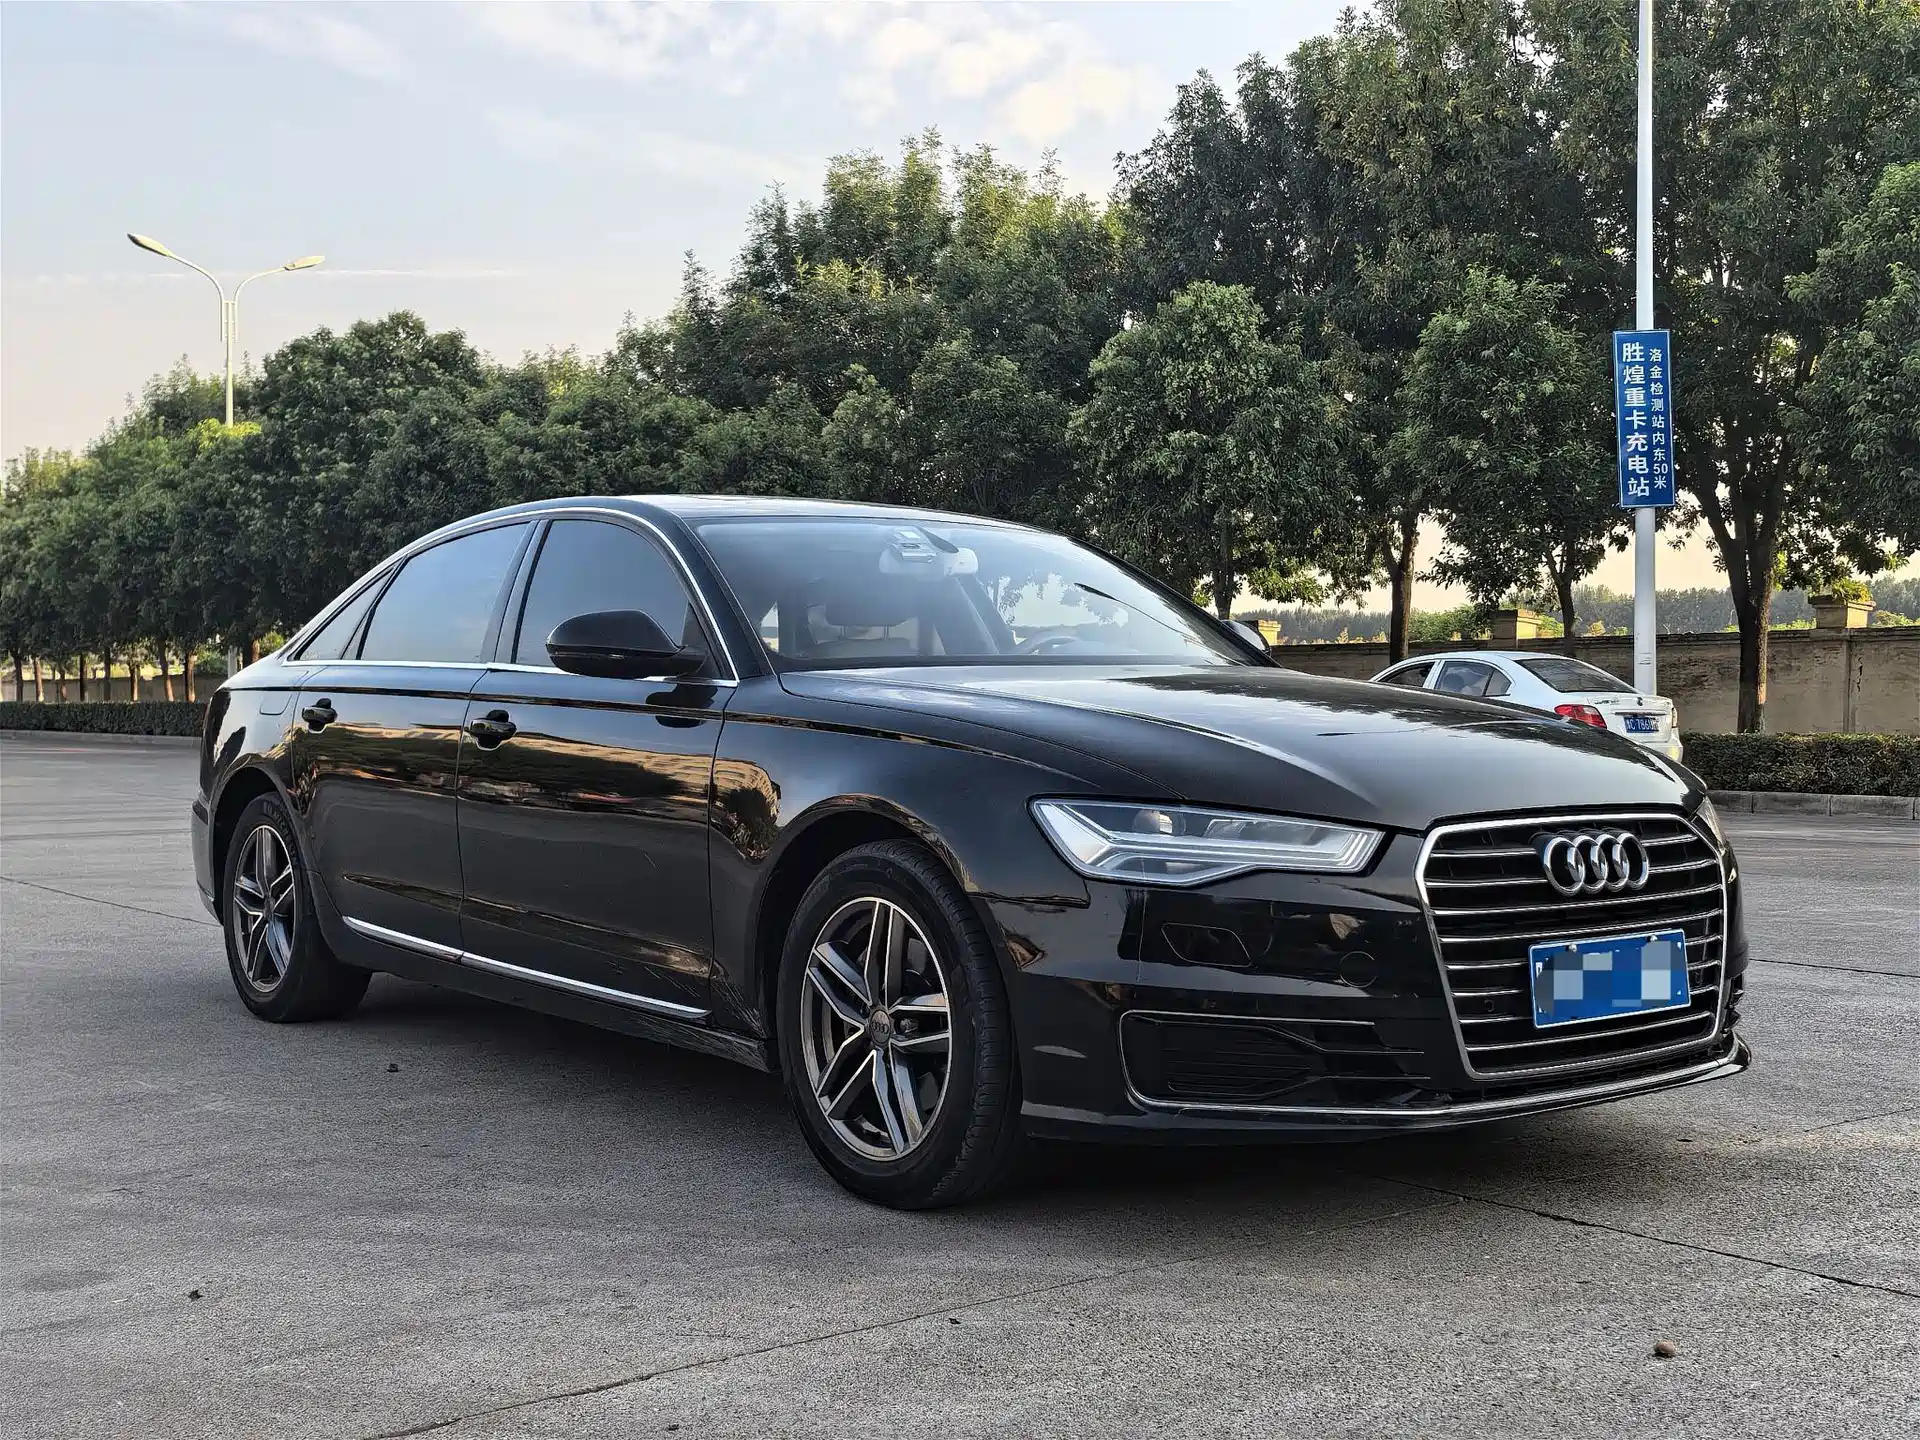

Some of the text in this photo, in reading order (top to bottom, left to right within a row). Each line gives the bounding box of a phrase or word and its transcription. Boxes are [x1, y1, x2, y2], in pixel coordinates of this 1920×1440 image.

[1622, 342, 1650, 497] 胜煌重卡充电站
[1649, 348, 1668, 489] 洛金检测站内东50米
